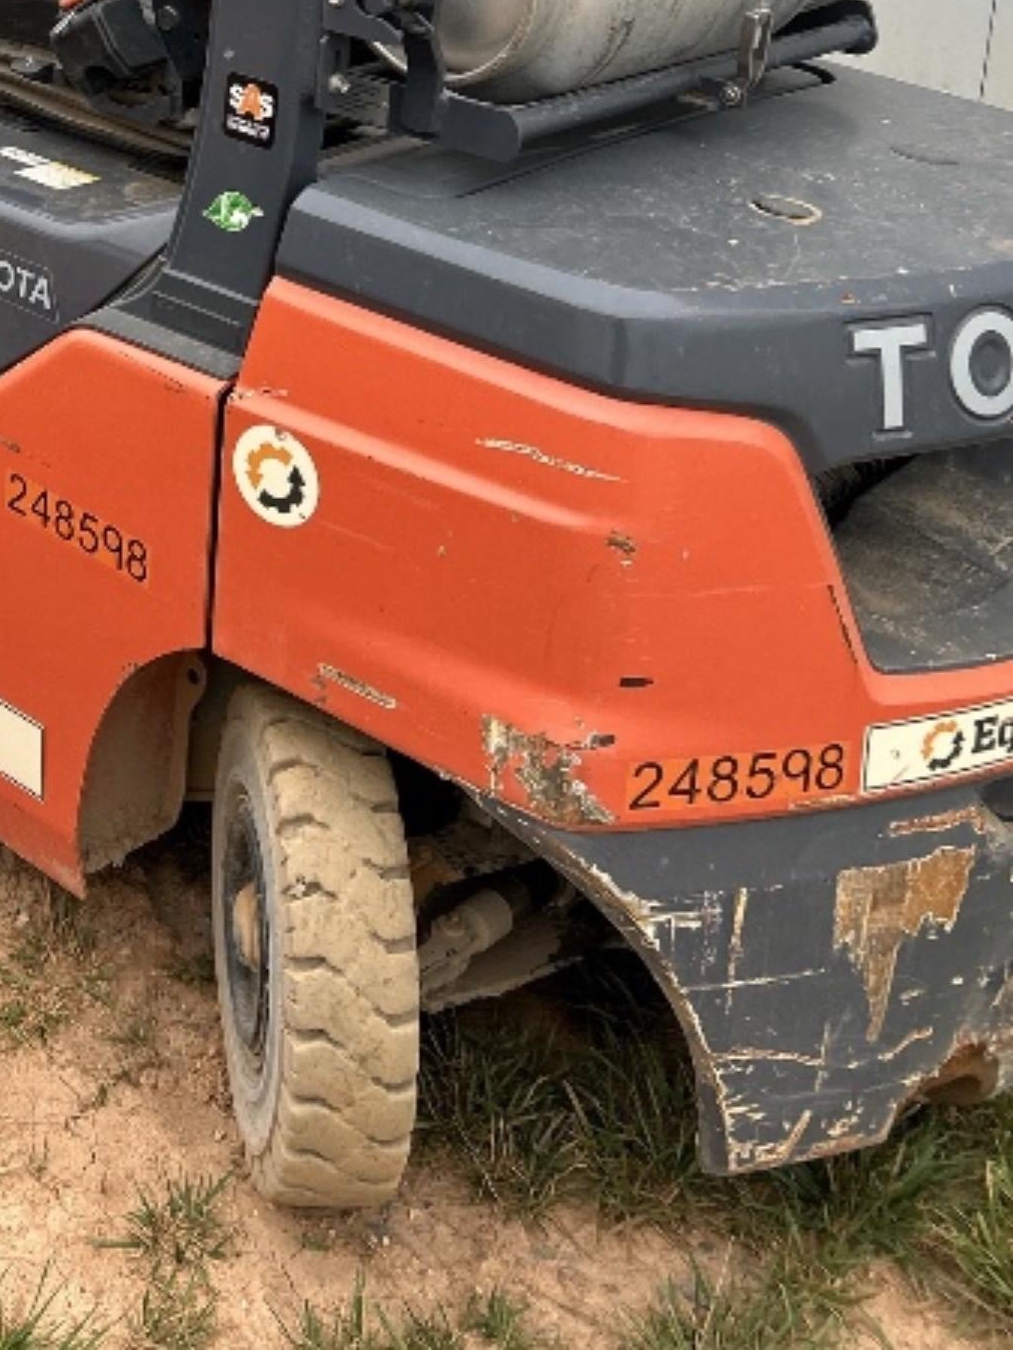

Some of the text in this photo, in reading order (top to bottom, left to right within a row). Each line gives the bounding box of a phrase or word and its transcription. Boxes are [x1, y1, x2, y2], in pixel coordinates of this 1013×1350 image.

[852, 310, 1013, 430] TO
[7, 473, 148, 582] 248598
[628, 743, 844, 811] 248598
